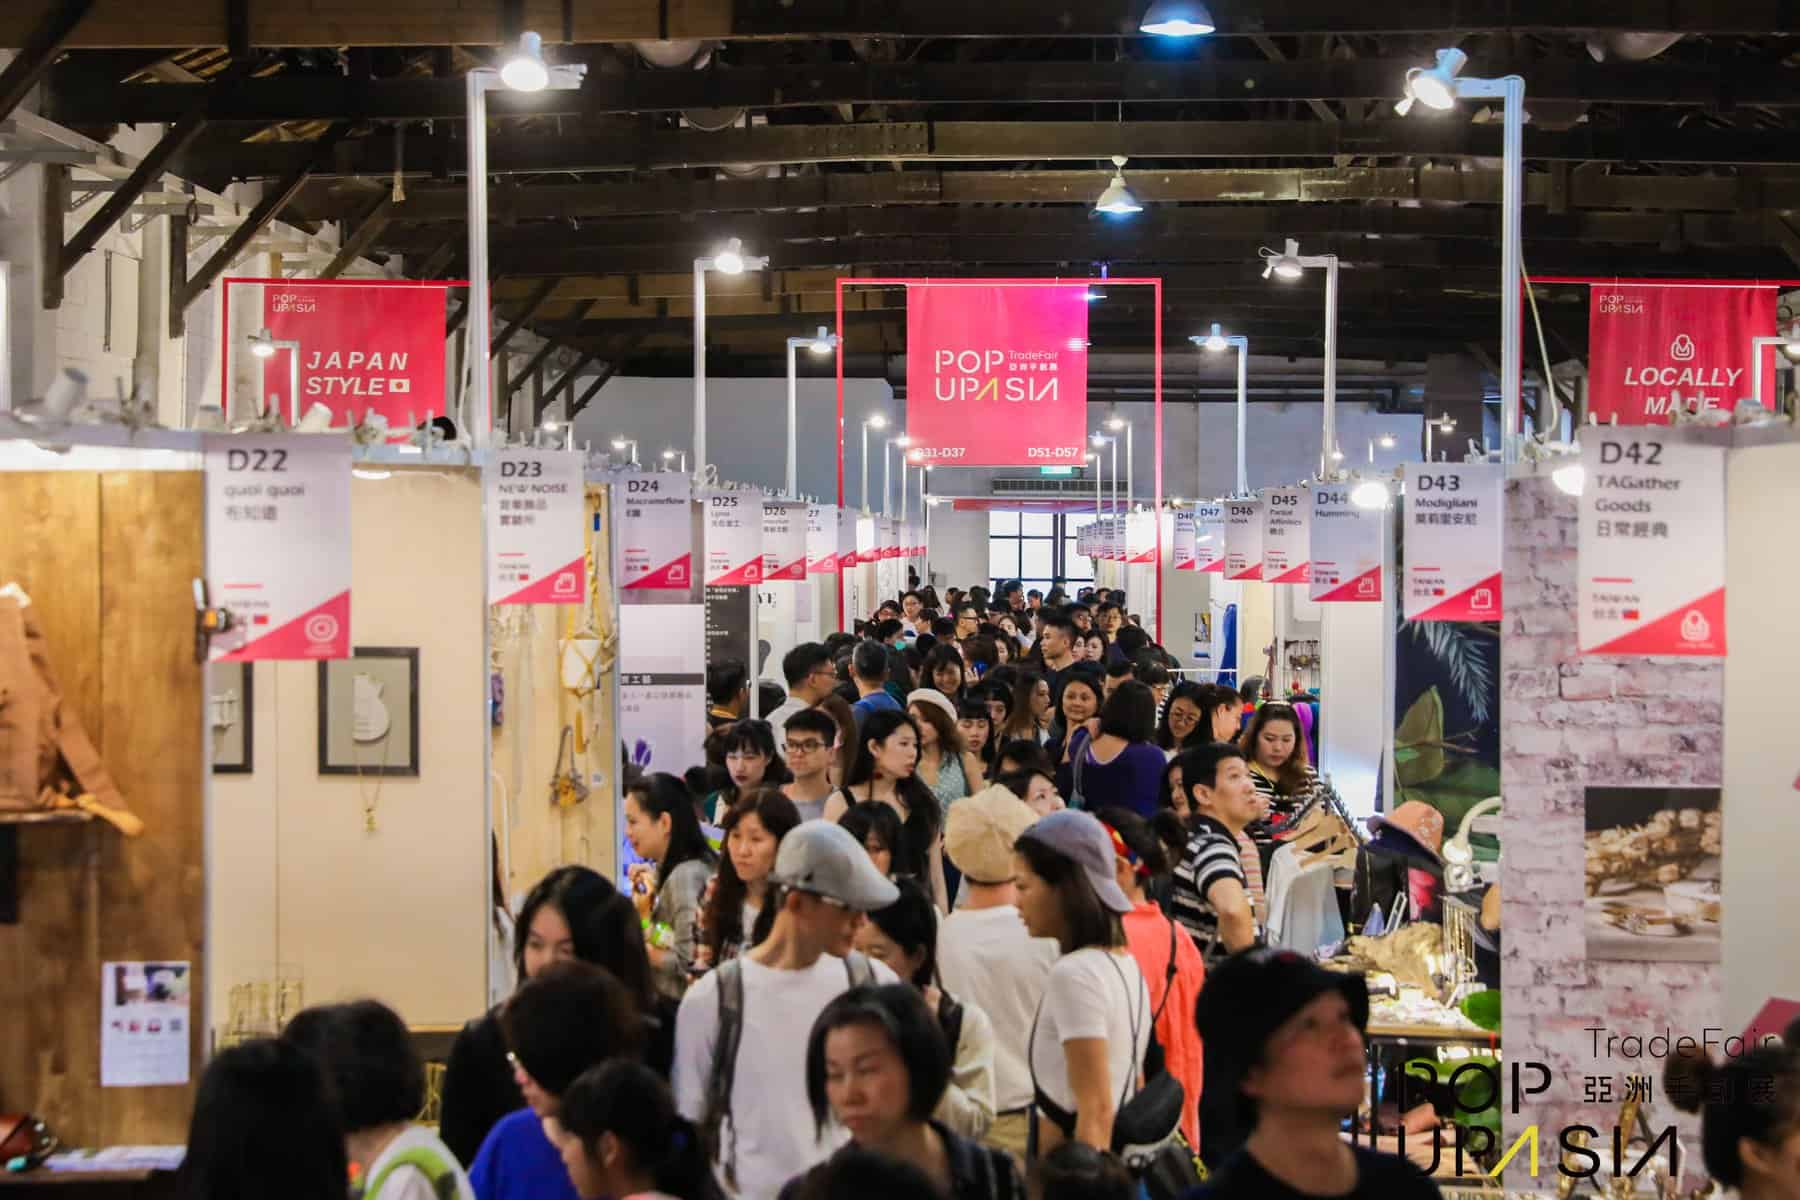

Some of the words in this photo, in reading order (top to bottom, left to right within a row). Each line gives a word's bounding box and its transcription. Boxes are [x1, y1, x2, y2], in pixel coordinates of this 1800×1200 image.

[272, 294, 297, 304] POP
[1599, 295, 1624, 304] POP
[306, 351, 409, 371] JAPAN
[935, 350, 1004, 374] POP
[1008, 350, 1058, 361] TradeFair
[1624, 367, 1744, 387] LOCALLY
[305, 377, 385, 396] STYLE
[1027, 447, 1079, 458] D51-D57
[1601, 442, 1664, 465] D42
[227, 449, 288, 472] D22
[501, 461, 543, 477] D23
[531, 484, 567, 493] NOISE
[628, 480, 659, 493] D24
[1418, 475, 1461, 491] D43
[1595, 475, 1681, 491] TAGather
[712, 496, 738, 507] D25
[1271, 495, 1298, 506] D45
[1415, 499, 1478, 510] Modigliani
[1595, 498, 1652, 513] Goods
[764, 506, 786, 516] D26
[1200, 508, 1220, 516] D47
[1231, 506, 1254, 516] D46
